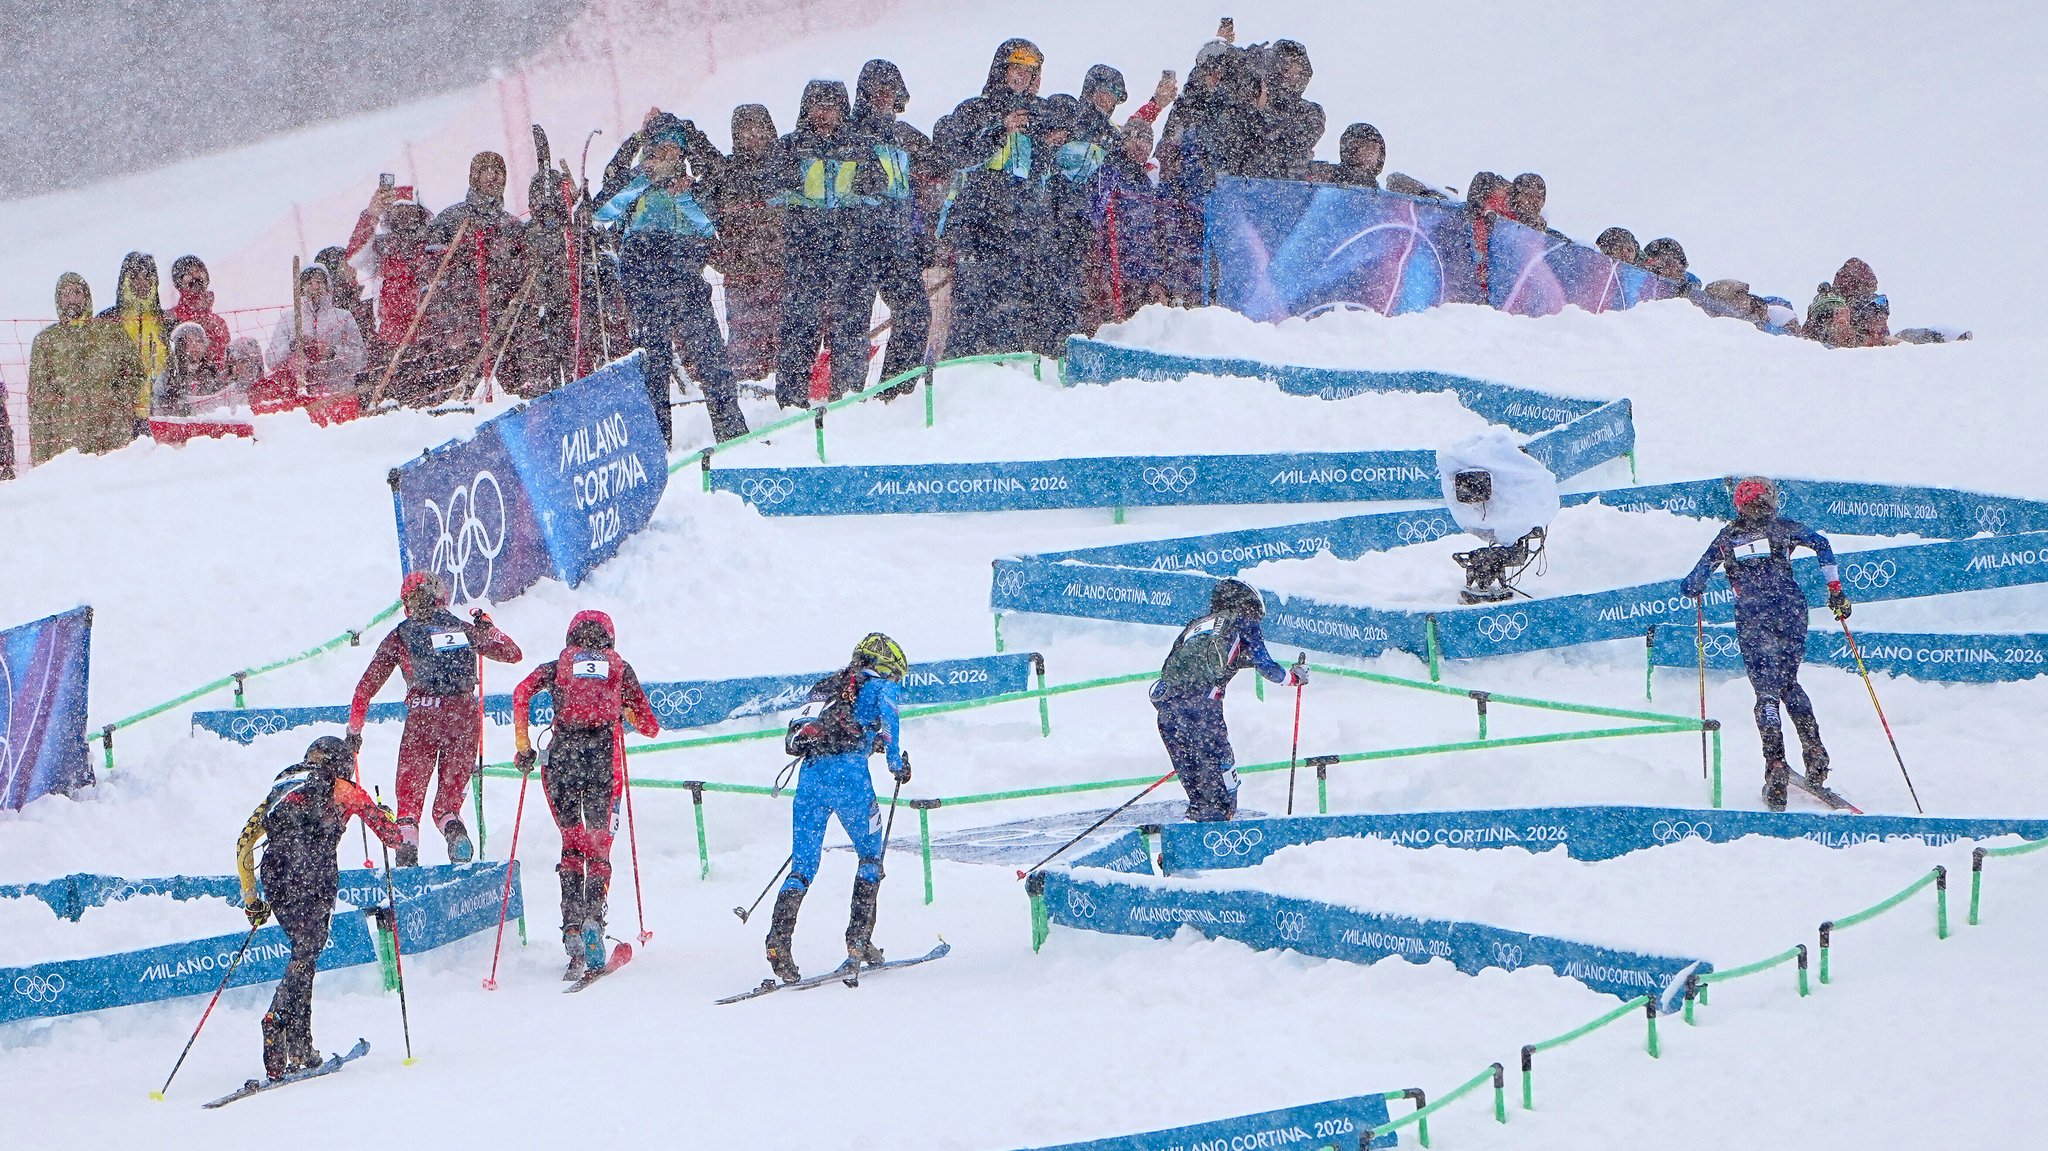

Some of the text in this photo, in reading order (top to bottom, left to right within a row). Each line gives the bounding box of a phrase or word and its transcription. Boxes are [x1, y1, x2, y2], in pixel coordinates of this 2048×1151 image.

[1320, 386, 1355, 400] MILANO
[1503, 402, 1540, 419] MILANO
[560, 412, 628, 473] MILANO
[573, 453, 648, 511] CORTINA
[1270, 469, 1347, 484] MILANO
[1351, 466, 1429, 482] CORTINA
[867, 476, 1067, 496] MILANO CORTINA 2026
[1619, 496, 1696, 514] TINA 2026
[1826, 500, 1938, 519] MILANO CORTINA 2026
[588, 504, 620, 550] 2026
[1151, 537, 1331, 570] MILANO CORTINA 2026
[1748, 543, 1755, 553] 1
[1964, 550, 2036, 572] MILANO
[1062, 583, 1172, 606] MILANO CORTINA 2026
[1598, 600, 1665, 621] MILANO
[1277, 613, 1388, 641] MILANO CORTINA 2026
[444, 634, 455, 645] 2
[1830, 645, 2044, 663] MILANO CORTINA 2026
[586, 663, 596, 673] 3
[902, 669, 988, 688] TINA 2026
[535, 707, 555, 723] 20
[801, 705, 811, 717] 4
[1434, 827, 1521, 844] CORTINA
[1526, 826, 1569, 841] 2026
[336, 884, 432, 903] ORTINA 20
[448, 897, 474, 920] MILANO
[500, 885, 516, 901] 26
[1129, 906, 1246, 924] MILANO CORTINA 2026
[1341, 928, 1452, 957] MILANO CORTINA 2026
[139, 955, 214, 983] MILANO
[217, 943, 292, 970] CORTINA
[1563, 961, 1676, 989] MILANO CORTINA 20
[1161, 1117, 1354, 1151] ANO CORTINA 2026
